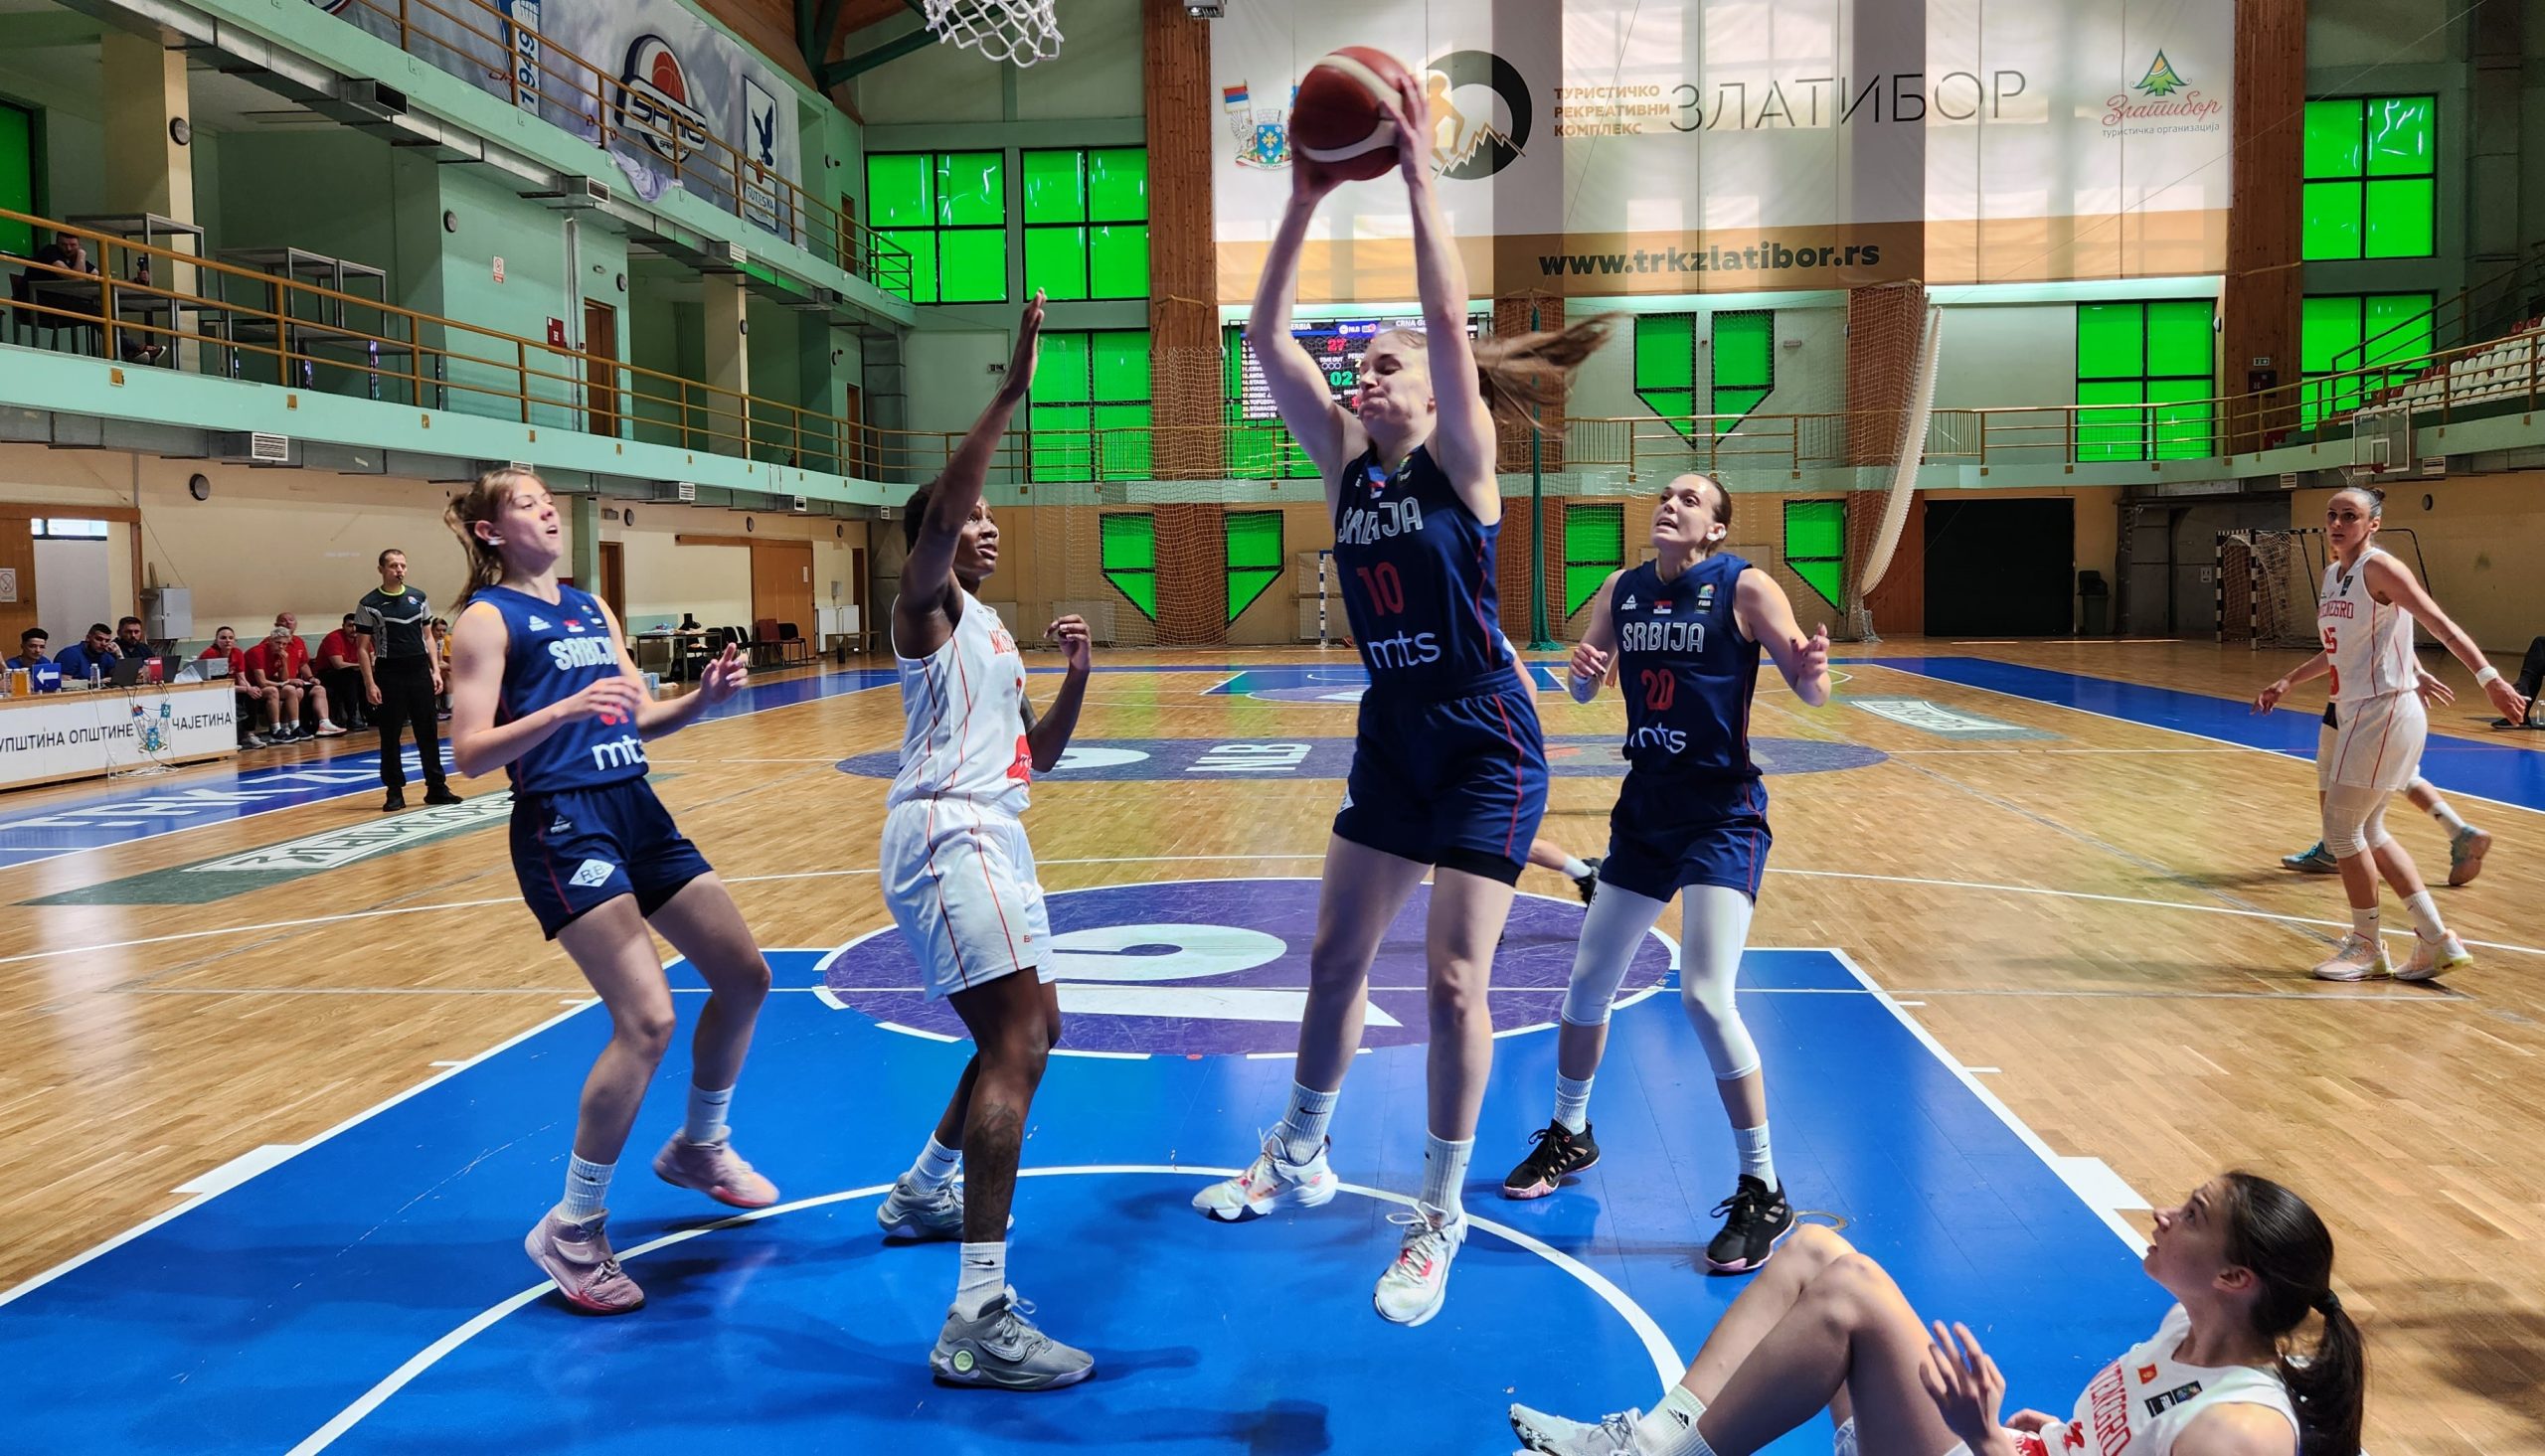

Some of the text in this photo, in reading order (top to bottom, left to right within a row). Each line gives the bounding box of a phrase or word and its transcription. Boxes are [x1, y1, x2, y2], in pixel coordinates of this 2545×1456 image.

[518, 30, 536, 105] 1949
[1554, 84, 1660, 100] ТУРИСТИЧКО
[1554, 102, 1671, 118] РЕКРЕАТИВНИ
[1670, 70, 2027, 132] ЗЛАТИБОР
[1554, 122, 1643, 137] КОМПЛЕКС
[2103, 122, 2220, 138] туристичка организација
[1538, 241, 1881, 276] www.trkzlatibor.rs
[1337, 496, 1425, 545] SRJA
[1356, 561, 1405, 616] 10
[548, 636, 619, 672] SRBIJ
[1367, 630, 1442, 670] mts
[1621, 621, 1706, 653] SRBIJA
[1640, 668, 1676, 711] 20
[69, 723, 135, 745] ОПШТИНЕ
[172, 711, 233, 731] ЧАЈЕТИНА
[591, 734, 647, 771] mt
